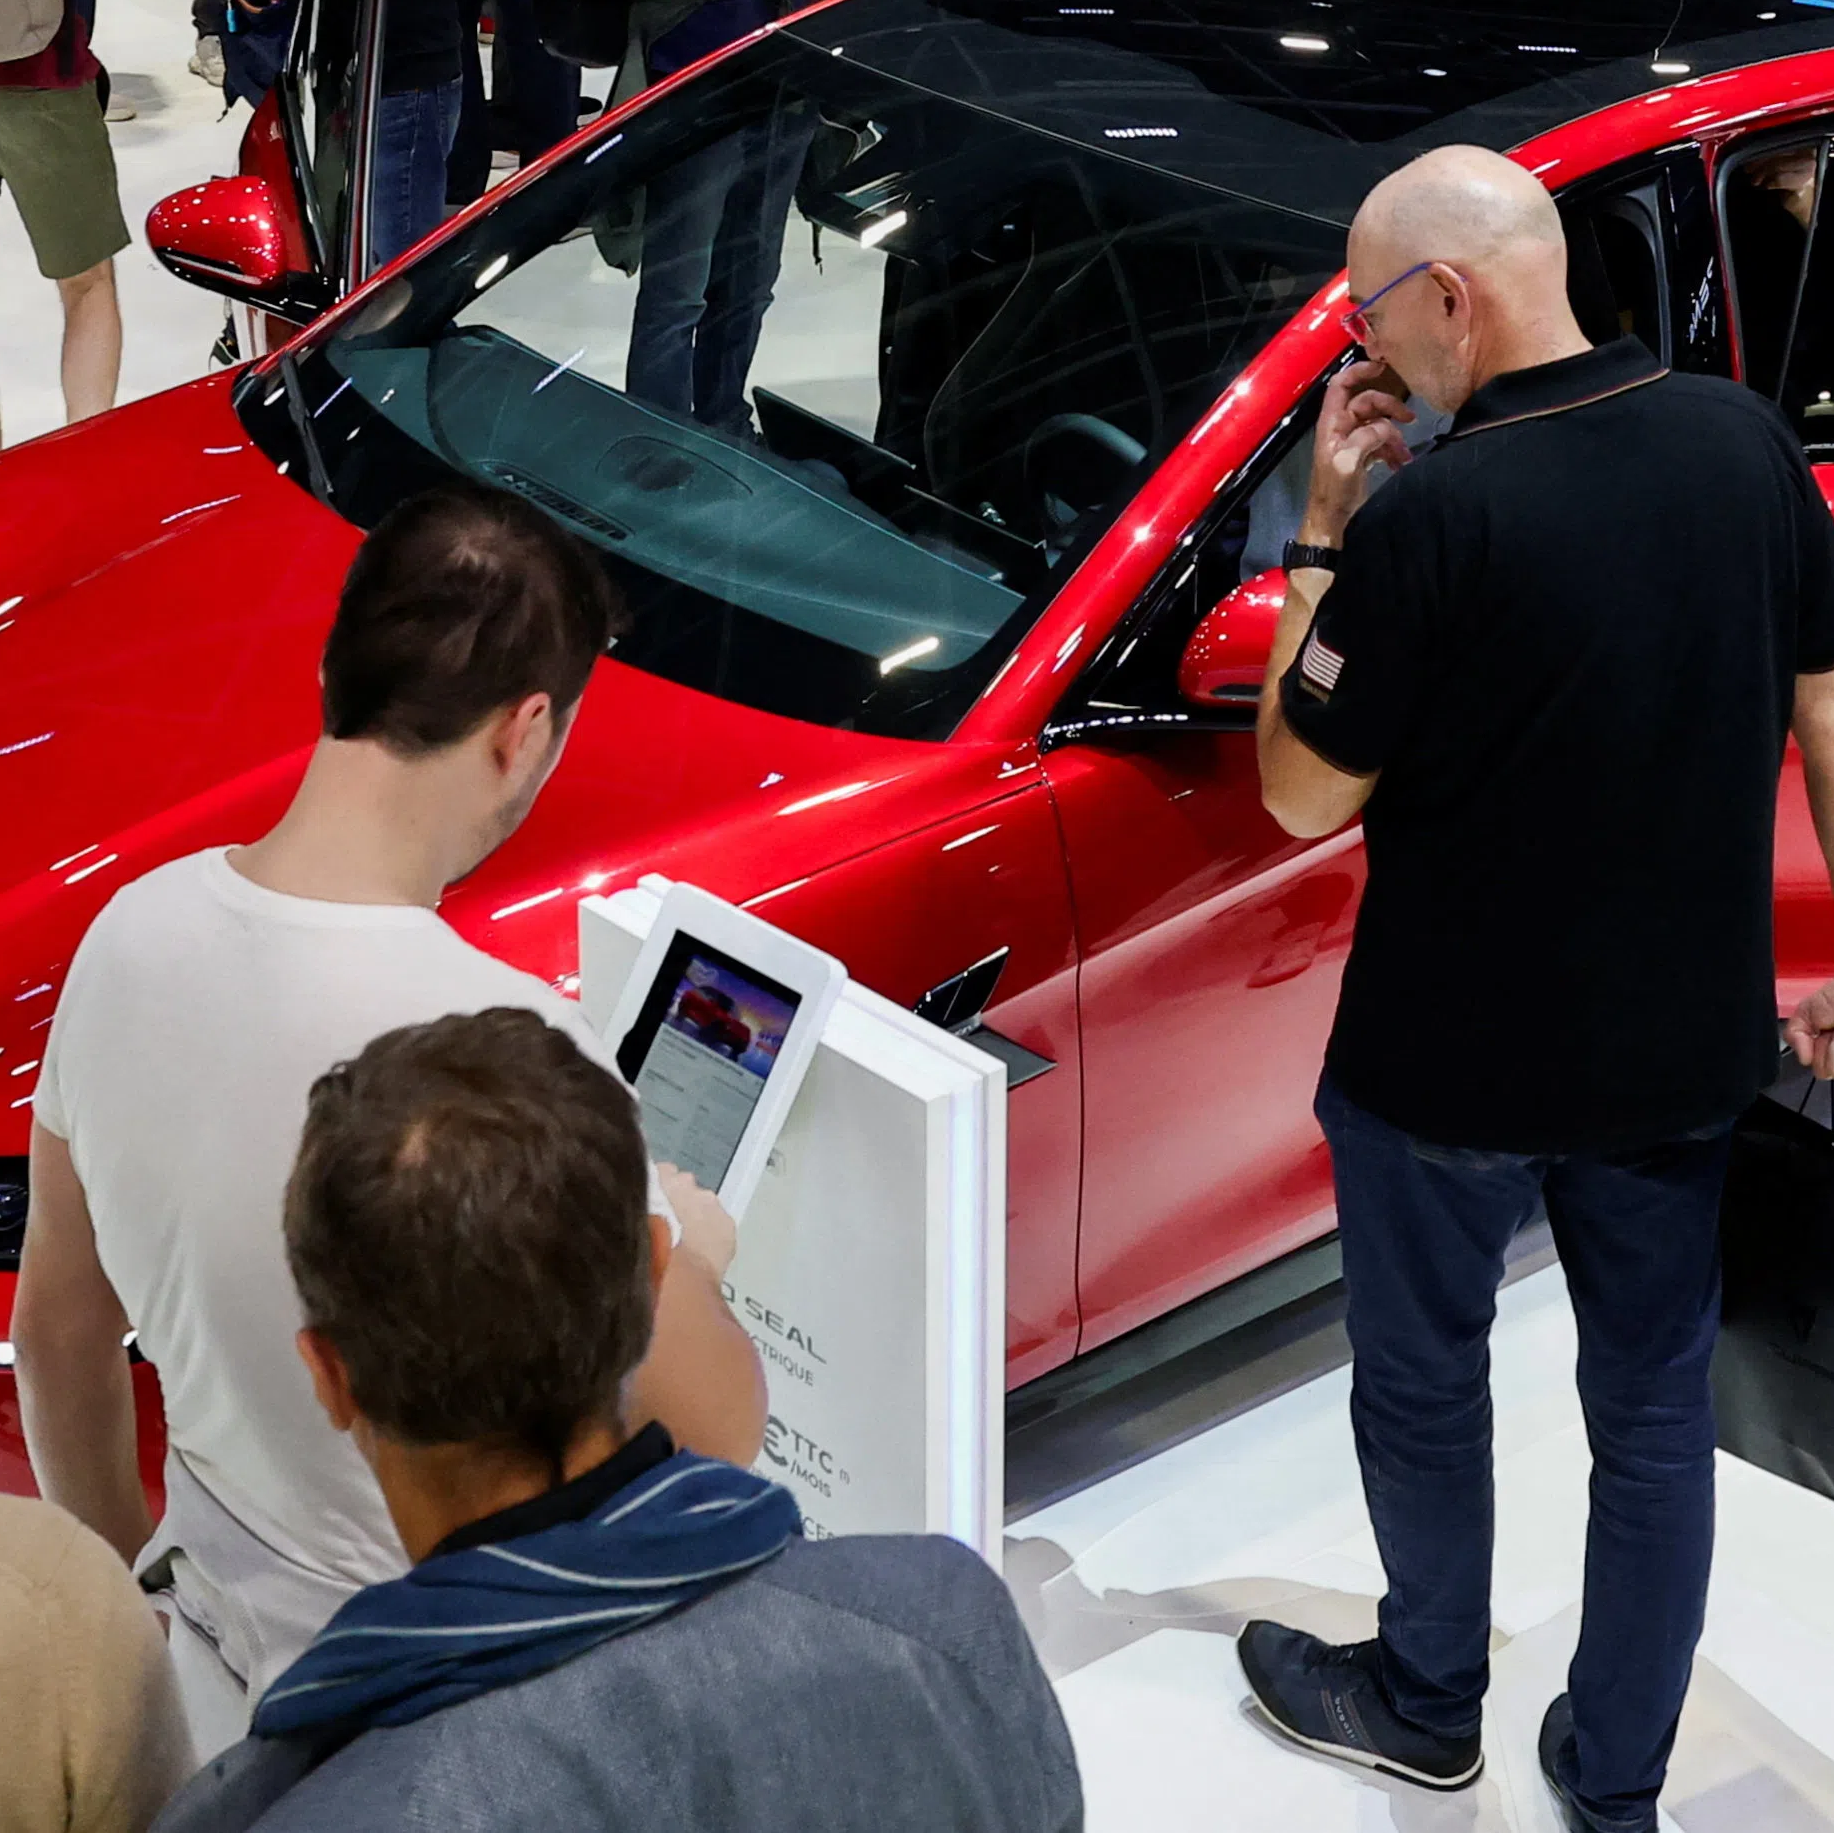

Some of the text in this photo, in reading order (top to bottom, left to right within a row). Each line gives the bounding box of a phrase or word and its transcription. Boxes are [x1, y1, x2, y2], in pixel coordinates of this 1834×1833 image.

[744, 1295, 828, 1366] SEAL
[790, 1428, 834, 1475] TTC
[789, 1459, 832, 1498] /MOIS
